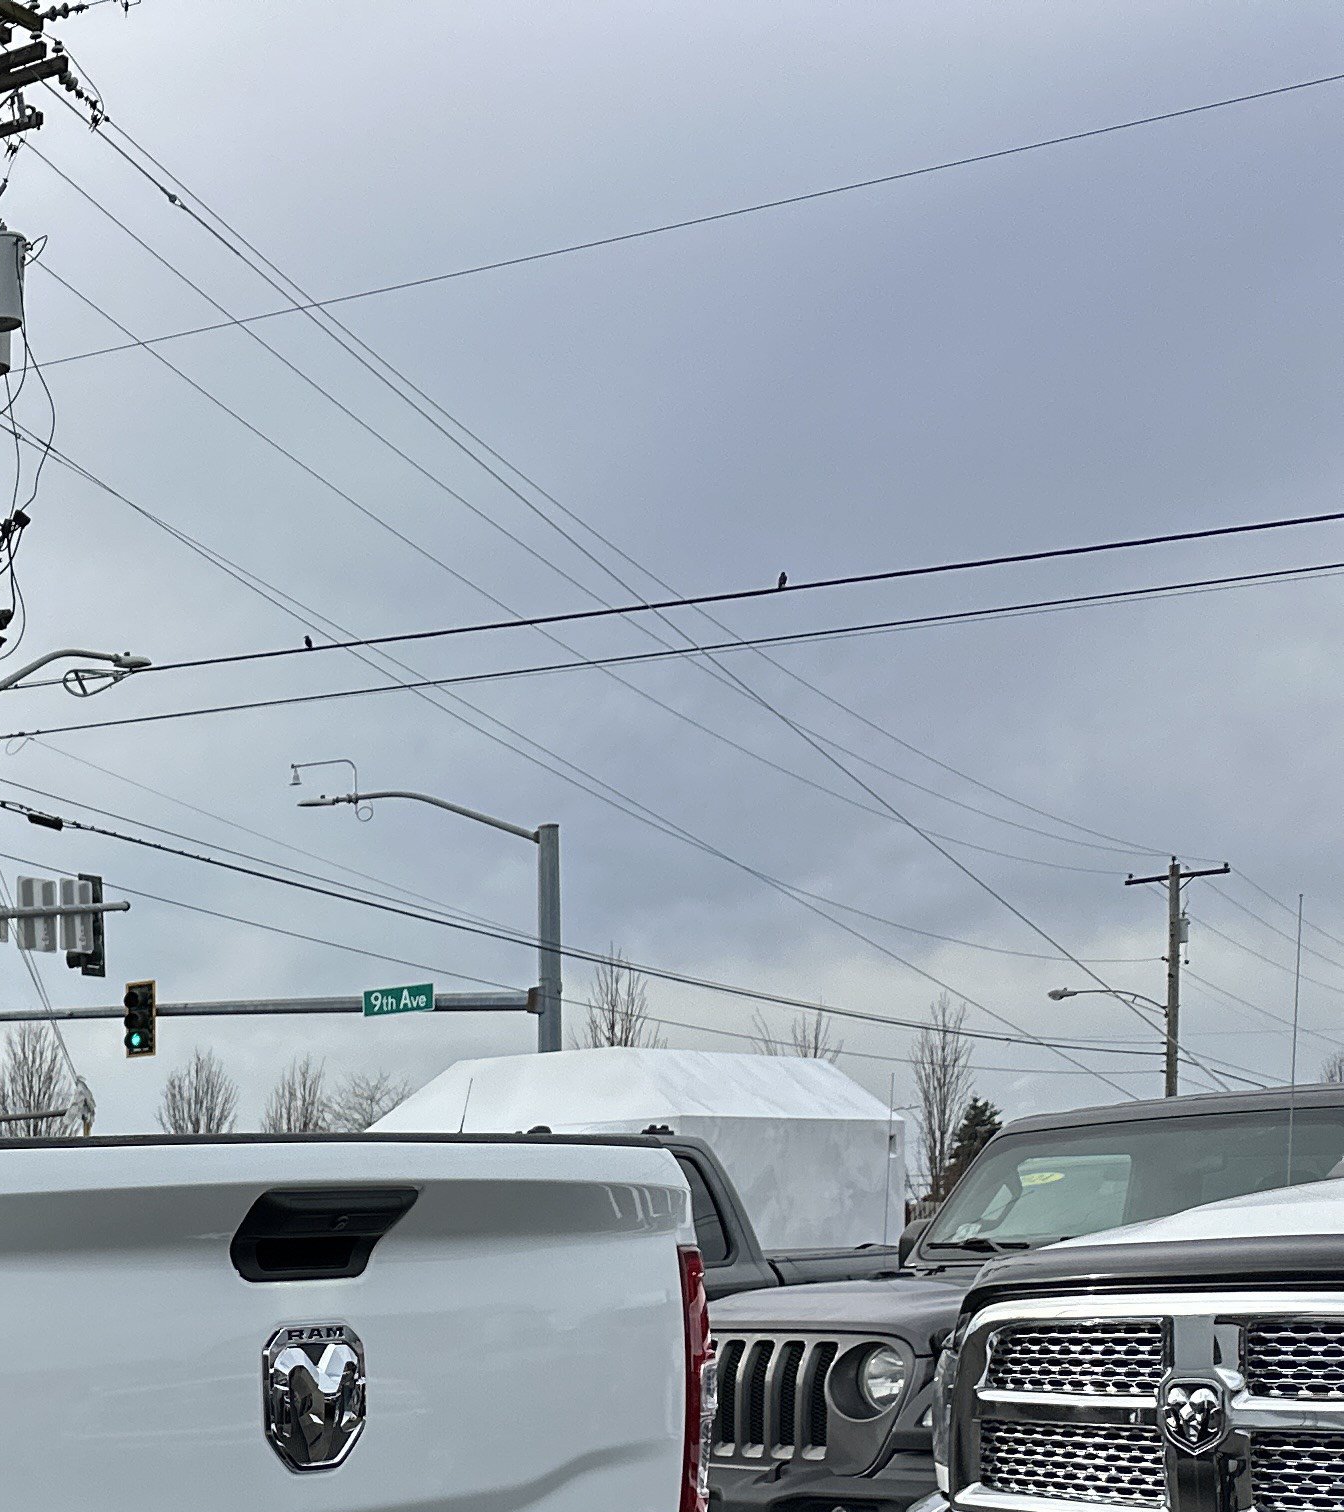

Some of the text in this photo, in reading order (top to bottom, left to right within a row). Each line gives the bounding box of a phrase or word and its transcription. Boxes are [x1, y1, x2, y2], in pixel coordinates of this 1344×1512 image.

[370, 988, 427, 1012] 9th Ave
[287, 1326, 345, 1341] RAM
